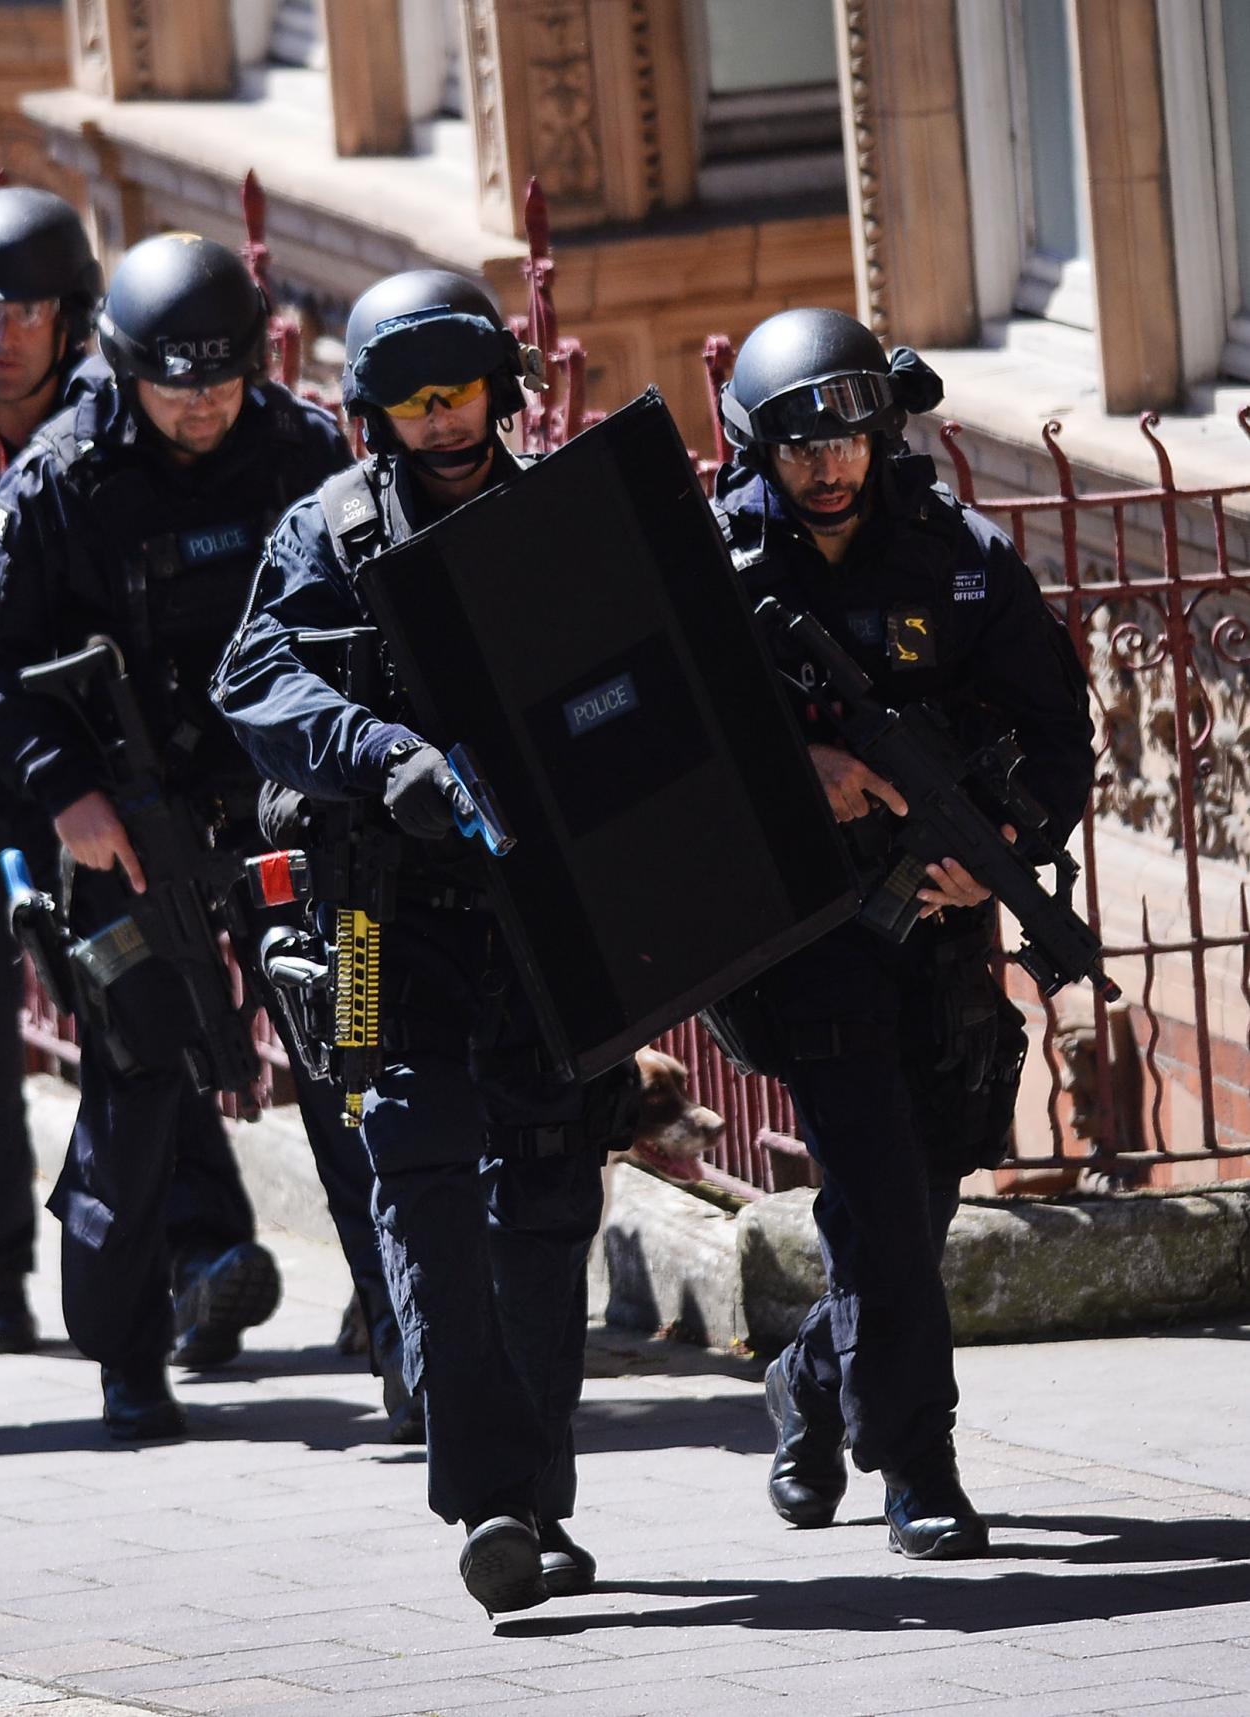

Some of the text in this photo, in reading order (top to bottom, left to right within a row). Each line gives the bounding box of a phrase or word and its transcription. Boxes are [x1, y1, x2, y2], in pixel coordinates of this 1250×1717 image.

[164, 337, 231, 360] POLICE
[343, 498, 360, 511] CO
[343, 504, 367, 523] 4297
[189, 529, 246, 558] POLICE
[953, 589, 986, 602] OFFICER
[574, 684, 629, 726] POLICE
